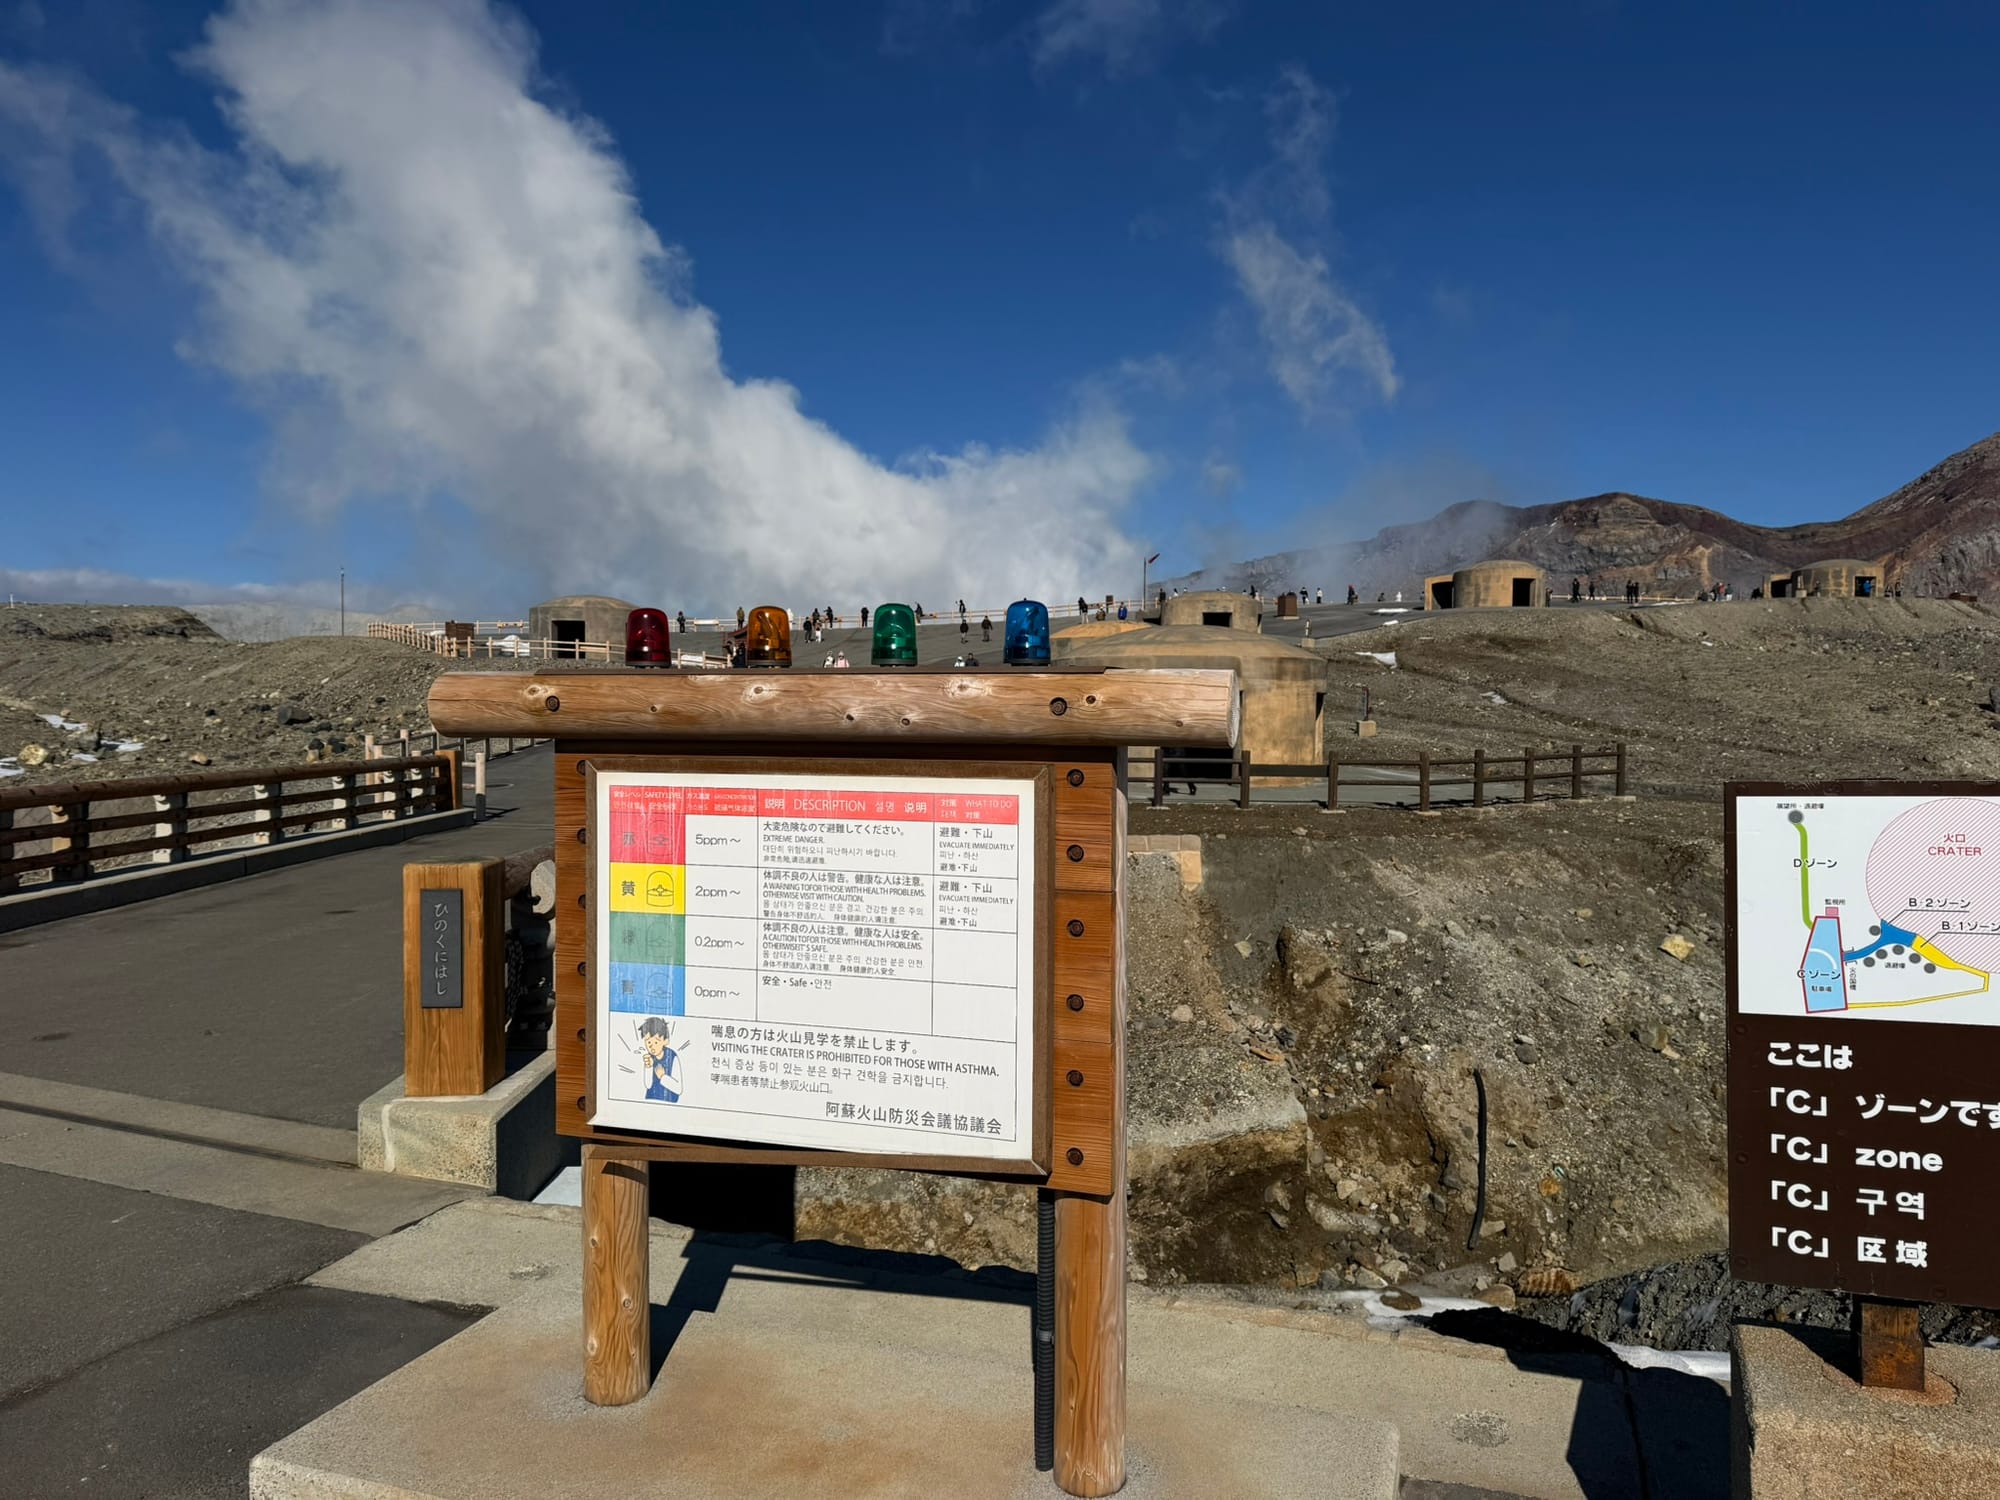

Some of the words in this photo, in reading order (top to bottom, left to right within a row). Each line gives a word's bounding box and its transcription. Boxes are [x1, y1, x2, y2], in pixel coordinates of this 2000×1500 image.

[793, 799, 866, 812] DESCRIPTION
[875, 802, 896, 813] 설명
[763, 834, 792, 843] EXTREME
[1943, 833, 1966, 843] 火口
[939, 841, 970, 849] EVACUATE
[972, 843, 1014, 851] IMMEDIATELY
[1928, 846, 1982, 856] CRATER
[622, 880, 636, 896] 黄
[823, 885, 845, 893] THOSE
[845, 886, 862, 894] WITH
[863, 887, 888, 895] HEALTH
[816, 893, 833, 901] WITH
[939, 894, 970, 903] EVACUATE
[972, 896, 1014, 905] IMMEDIATELY
[769, 934, 798, 943] CAUTION
[821, 936, 841, 945] THOSE
[842, 937, 859, 946] WITH
[860, 939, 885, 948] HEALTH
[434, 903, 449, 995] ひのくにはし
[711, 1025, 917, 1055] 喘息の方は火山見学を禁止します。
[711, 1042, 749, 1054] VISITING
[751, 1045, 768, 1056] THE
[770, 1047, 804, 1059] CRATER
[806, 1049, 814, 1060] IS
[816, 1051, 871, 1065] PROHIBITED
[873, 1055, 892, 1067] FOR
[894, 1057, 925, 1070] THOSE
[927, 1060, 952, 1072] WITH
[955, 1063, 1000, 1077] ASTHMA.
[1767, 1042, 1853, 1070] ここは
[711, 1057, 730, 1069] 천식
[736, 1059, 754, 1072] 증상
[759, 1061, 778, 1074] 등이
[783, 1063, 803, 1076] 있는
[807, 1065, 827, 1078] 분은
[832, 1067, 851, 1080] 화구
[857, 1069, 887, 1084] 견학을
[891, 1072, 949, 1089] 금지합니다.
[825, 1101, 1002, 1135] 阿蘇火山防災会議協議会
[1856, 1094, 2000, 1130] ゾーンです
[1855, 1148, 1944, 1172] zone
